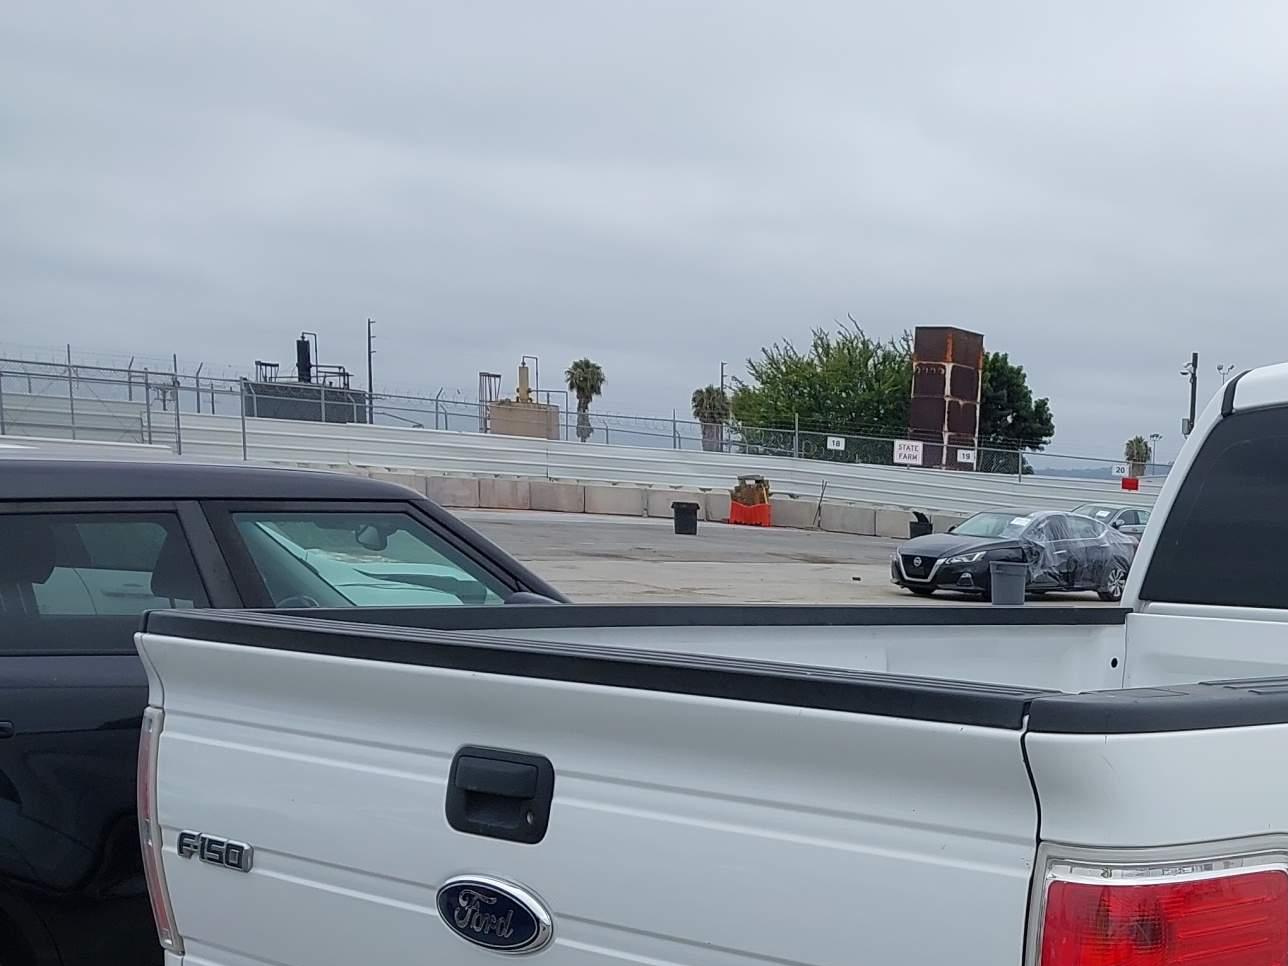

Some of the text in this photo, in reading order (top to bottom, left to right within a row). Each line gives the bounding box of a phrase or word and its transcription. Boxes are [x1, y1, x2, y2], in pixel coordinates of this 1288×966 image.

[898, 444, 919, 452] STATE
[898, 453, 918, 461] FARM
[1115, 466, 1126, 474] 20
[178, 830, 252, 872] F-150
[453, 888, 515, 939] Ford
